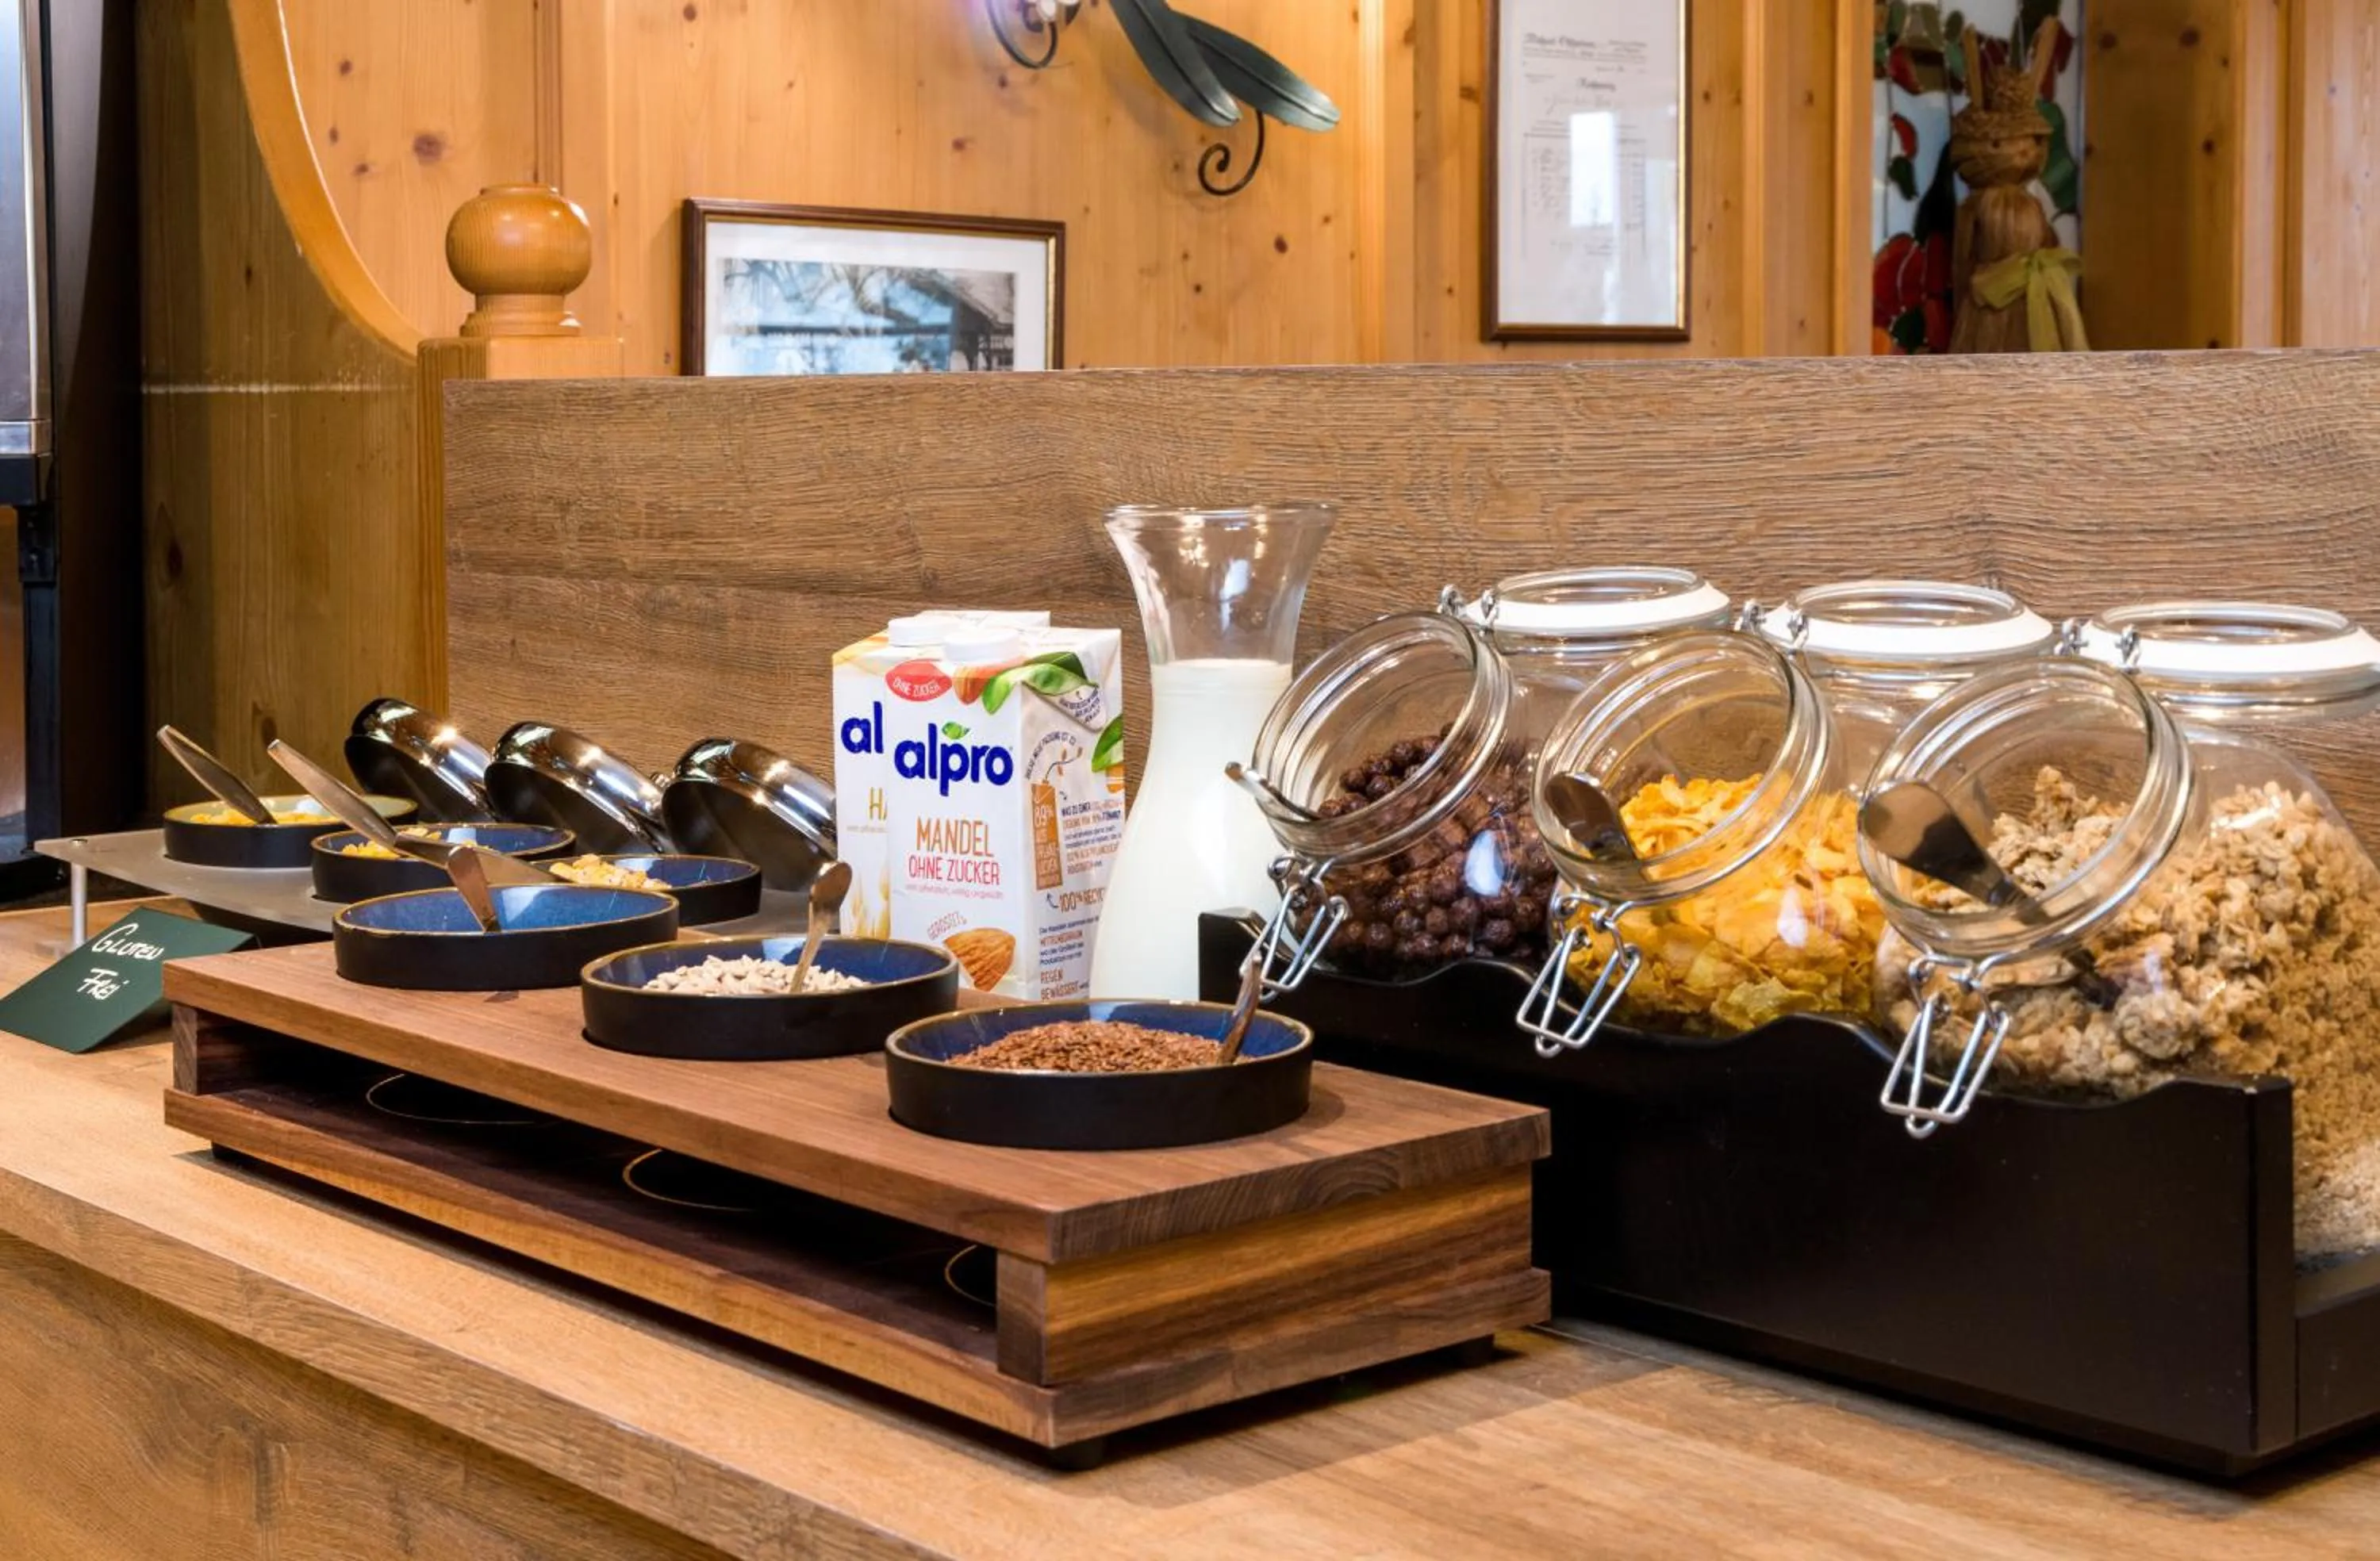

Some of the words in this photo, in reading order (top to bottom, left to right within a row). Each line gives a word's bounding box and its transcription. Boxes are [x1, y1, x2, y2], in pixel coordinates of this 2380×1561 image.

[894, 723, 1013, 796] alpro
[916, 815, 994, 857] MANDEL
[908, 854, 943, 880] OHNE
[946, 859, 1000, 885] ZUCKER
